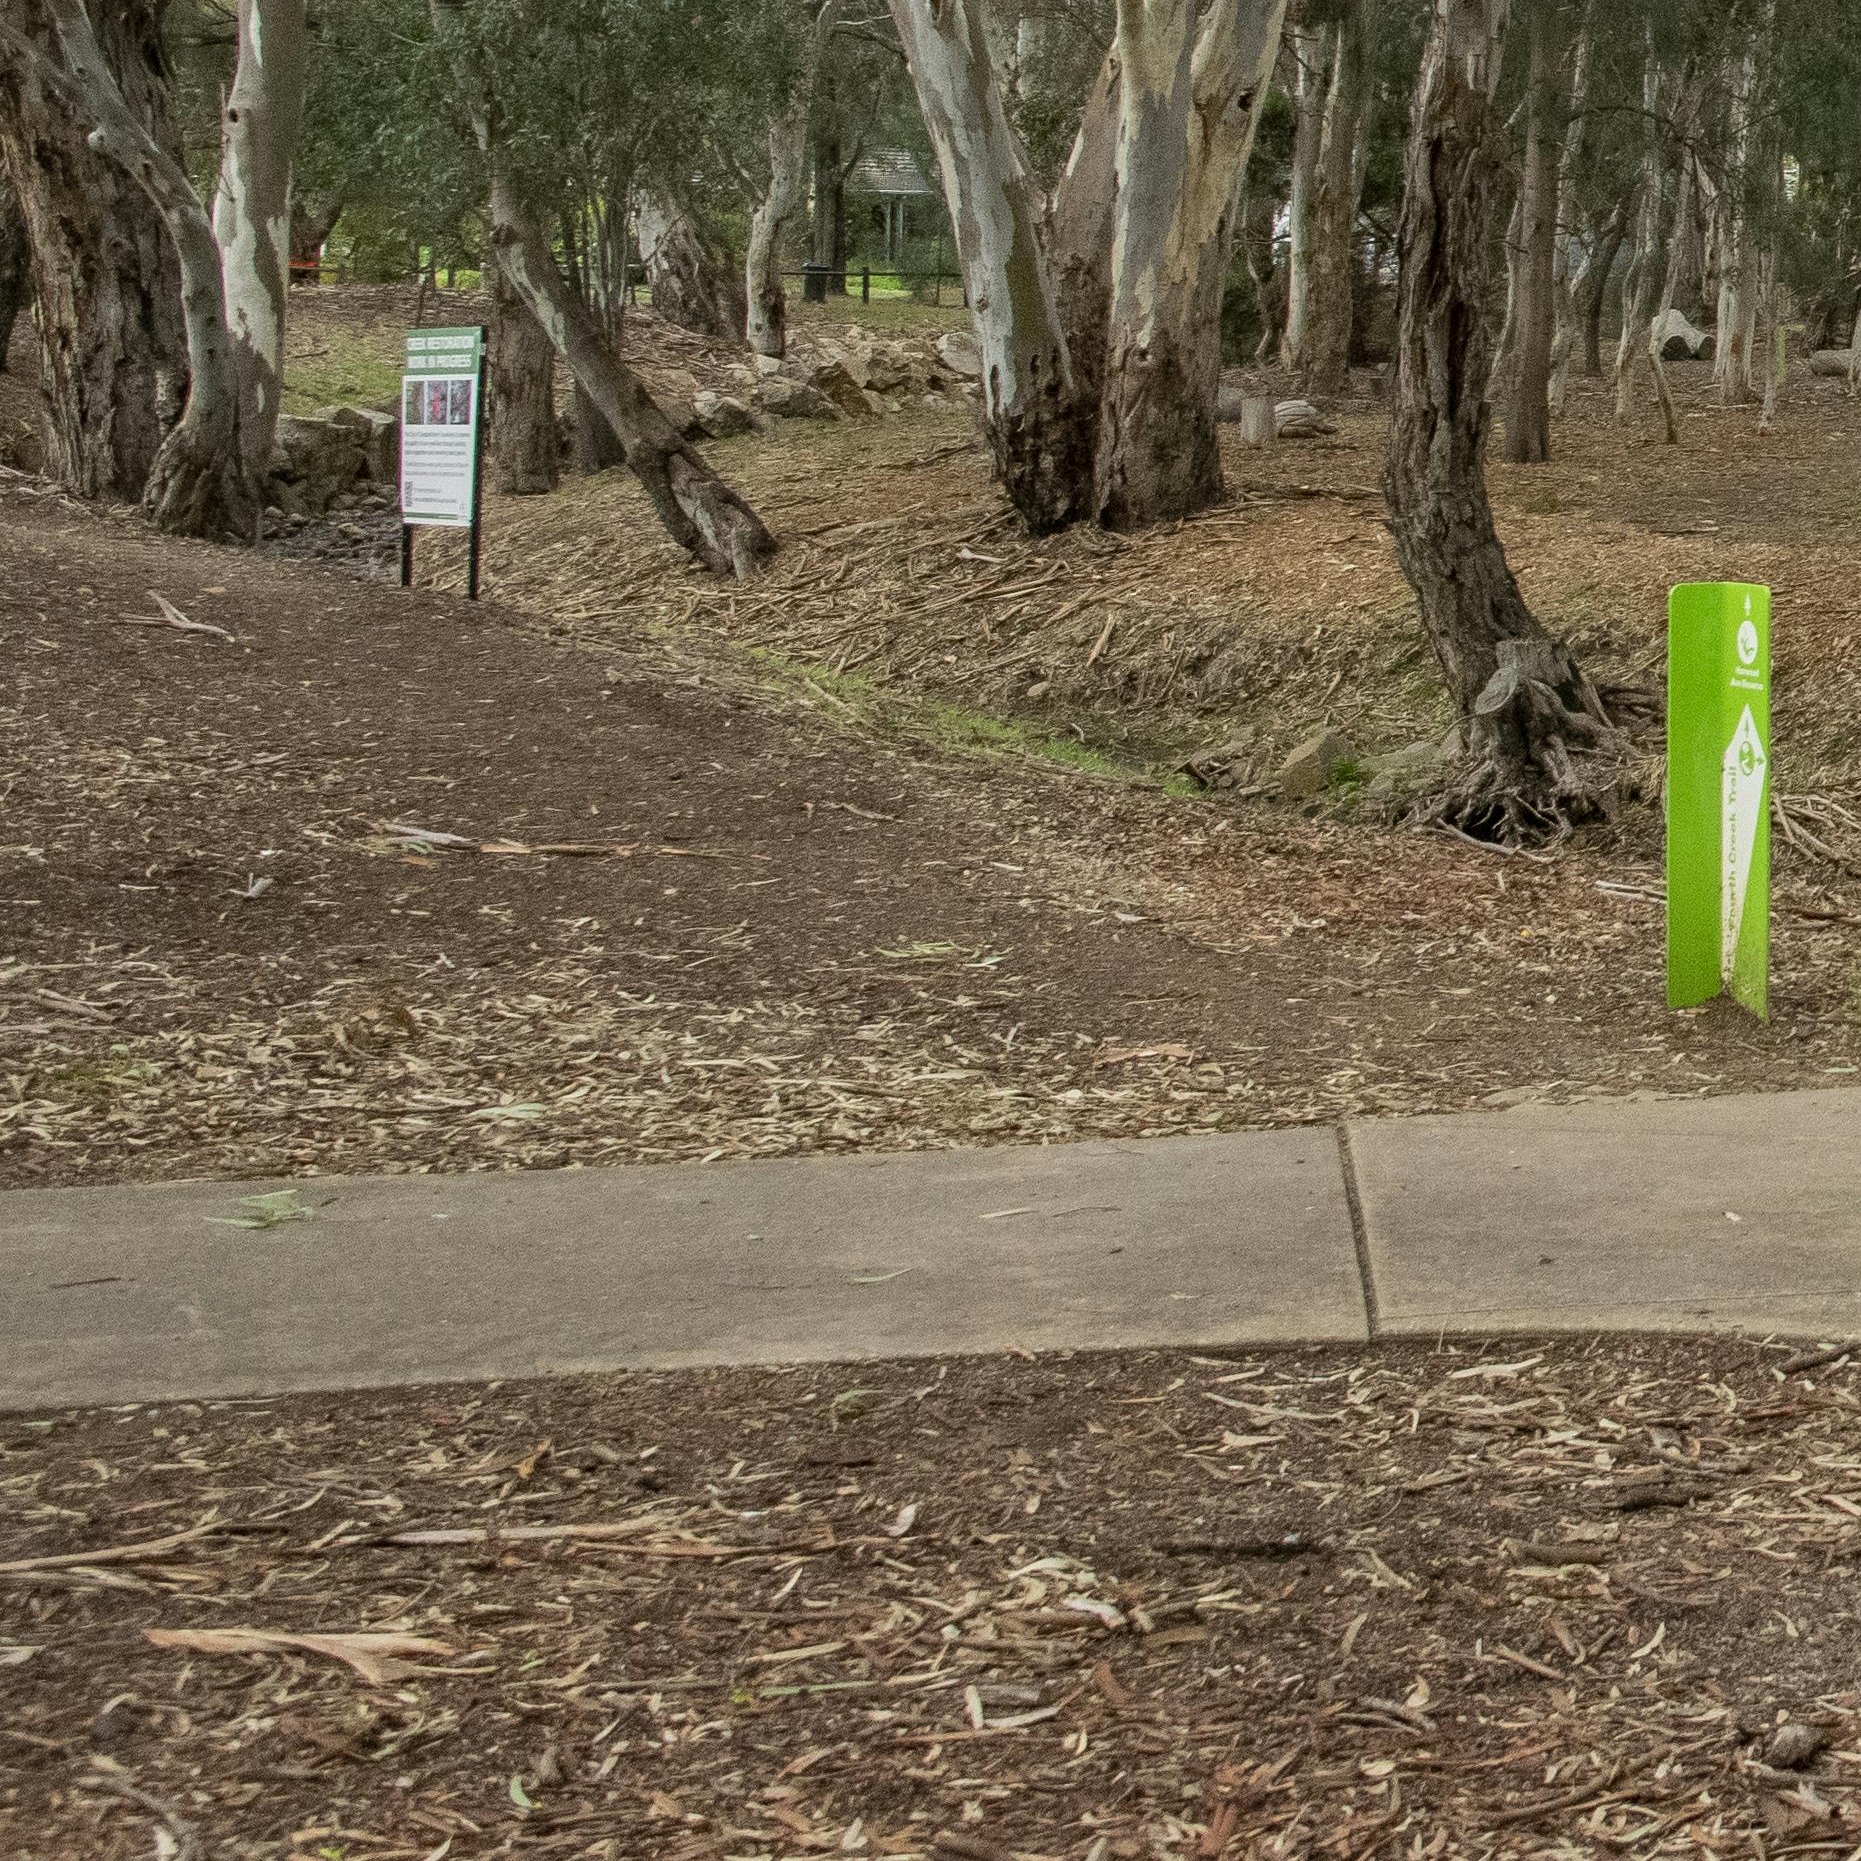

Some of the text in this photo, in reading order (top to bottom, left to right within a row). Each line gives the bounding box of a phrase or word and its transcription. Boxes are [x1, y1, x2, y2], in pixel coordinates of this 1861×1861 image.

[1727, 766, 1738, 931] Fourth Creek Trail
